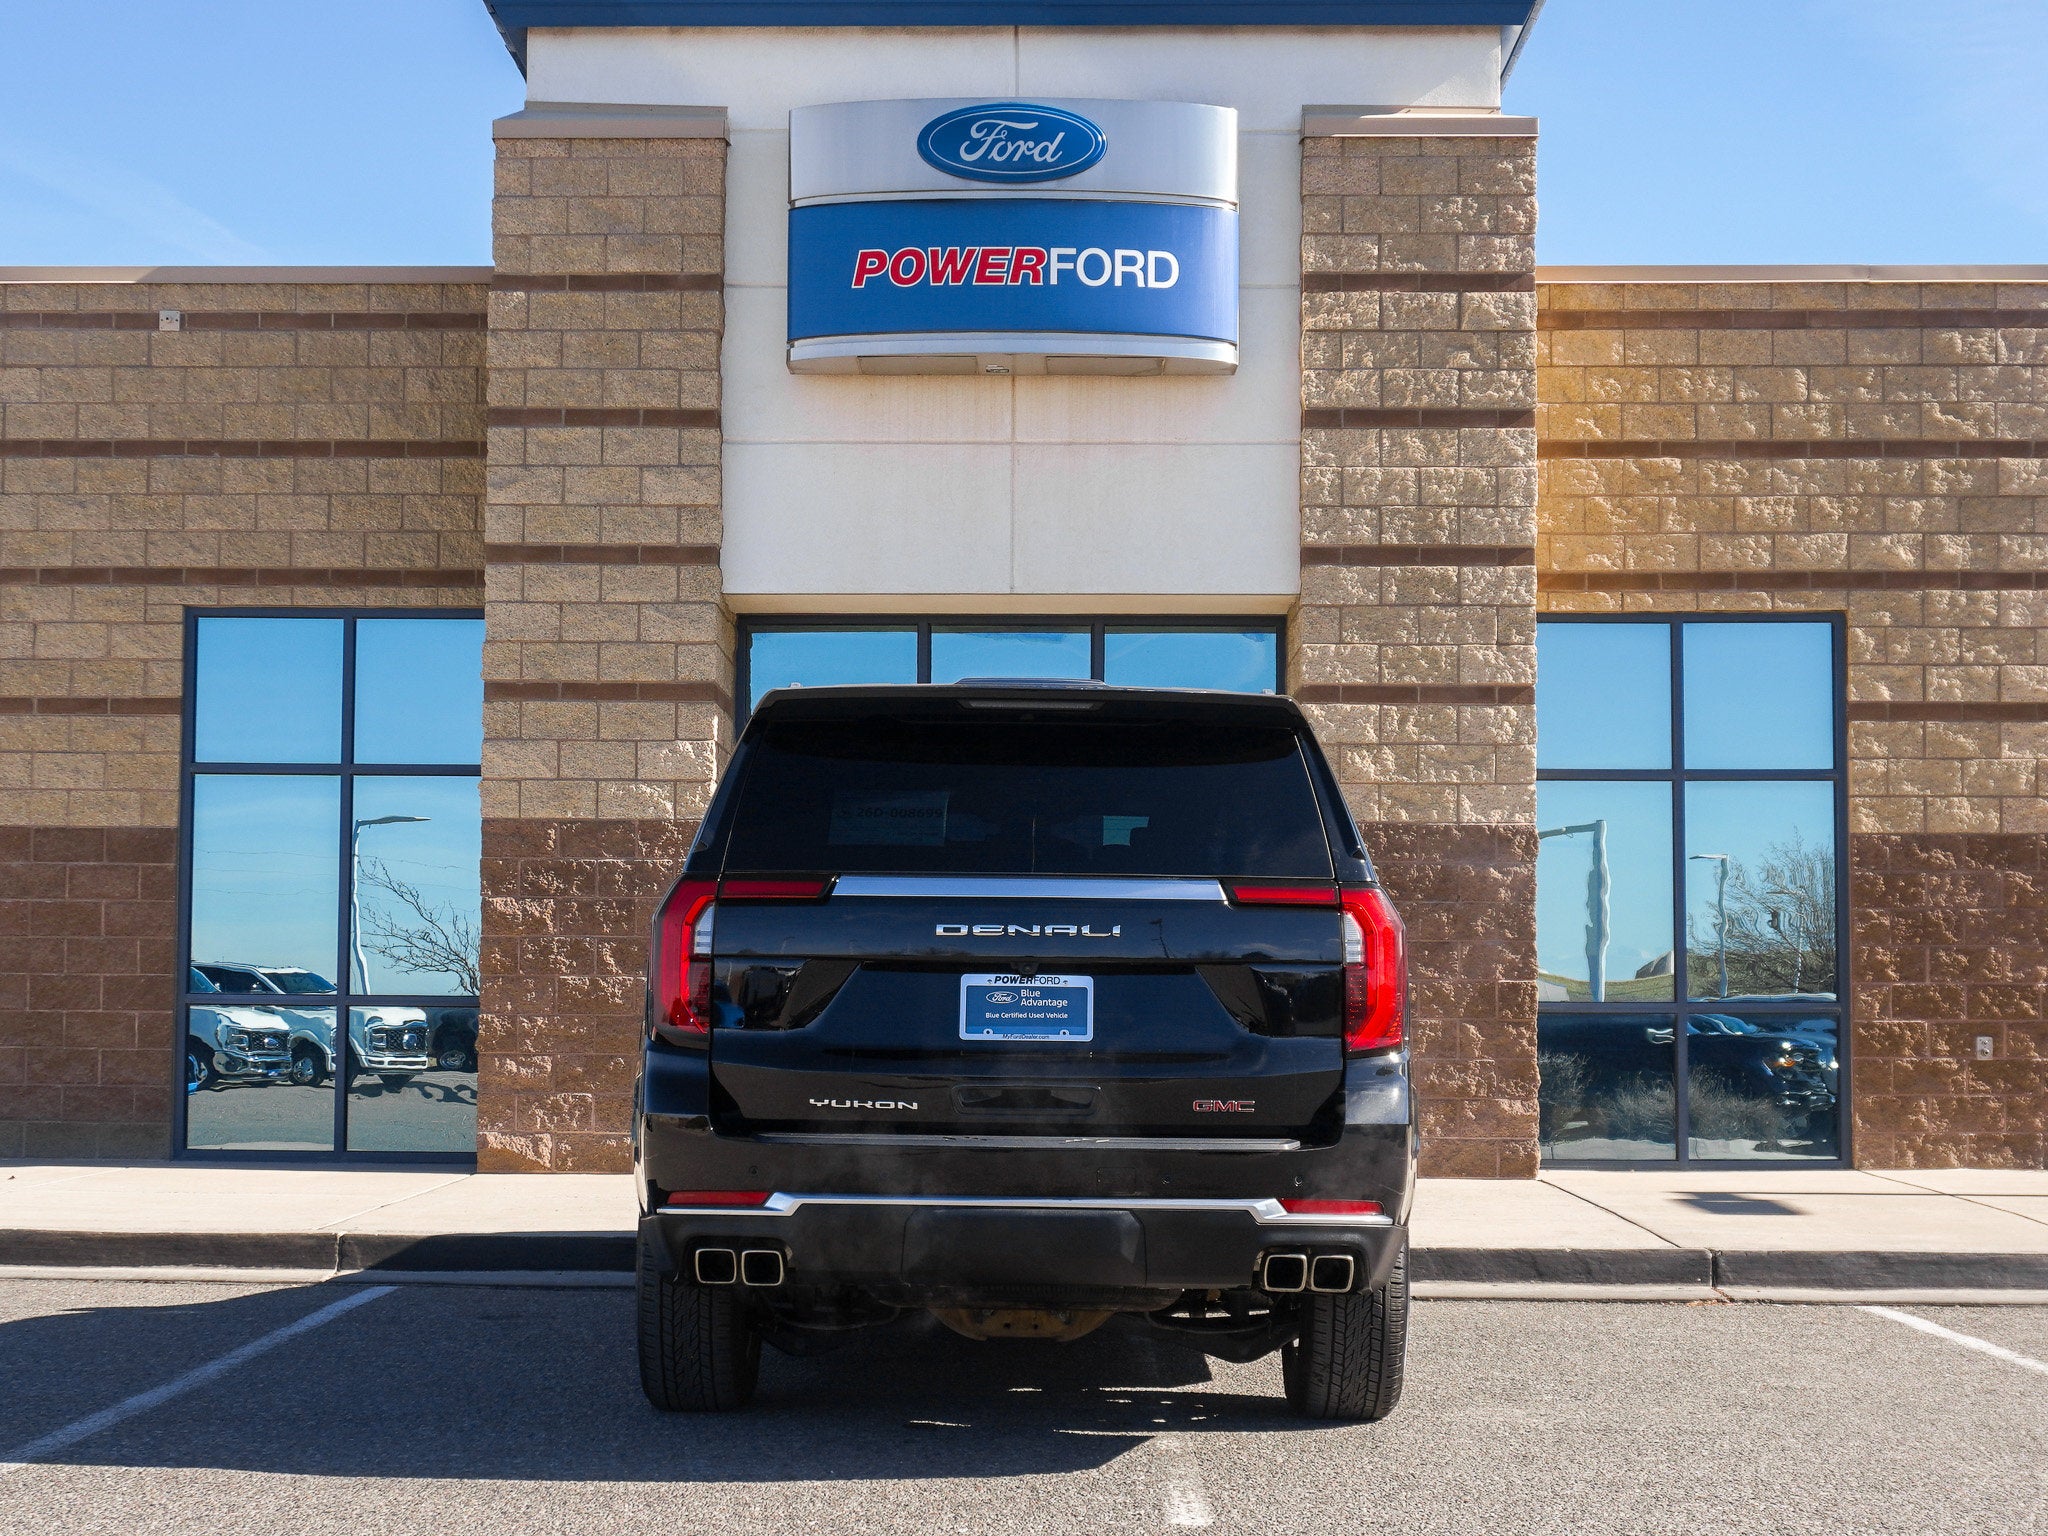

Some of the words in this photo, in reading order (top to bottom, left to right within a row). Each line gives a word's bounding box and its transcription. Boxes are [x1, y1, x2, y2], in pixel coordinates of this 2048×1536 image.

[959, 119, 1065, 162] Ford
[935, 924, 1121, 937] DENALI
[992, 993, 1012, 1002] Ford
[1021, 989, 1041, 997] Blue
[1021, 998, 1068, 1008] Advantage
[809, 1098, 918, 1110] YUKON
[1193, 1100, 1256, 1112] GMC
